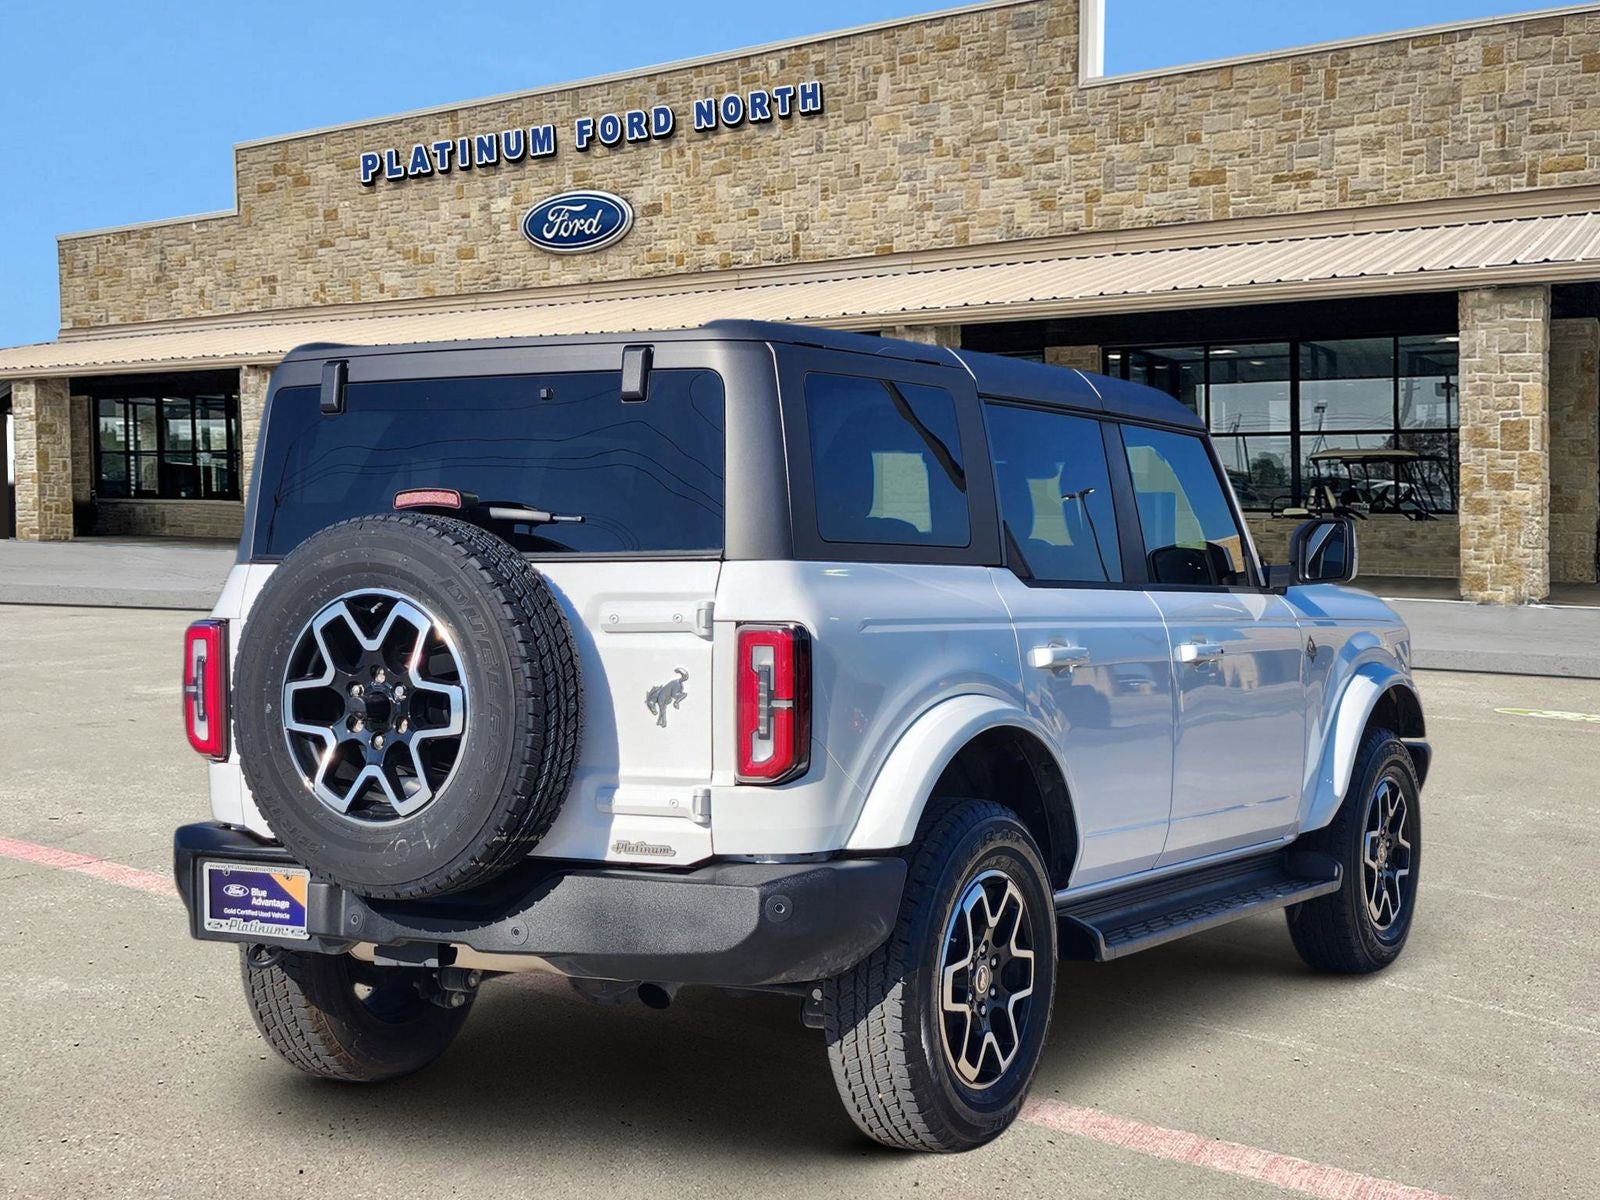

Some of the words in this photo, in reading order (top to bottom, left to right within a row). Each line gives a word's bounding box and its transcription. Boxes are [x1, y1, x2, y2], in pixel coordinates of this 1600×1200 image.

[360, 124, 556, 183] PLATINUM
[575, 104, 673, 149] FORD
[693, 81, 821, 130] NORTH
[542, 203, 603, 240] Ford
[614, 841, 672, 856] Platinum
[251, 888, 267, 897] Blue
[251, 897, 290, 909] Advantage
[237, 909, 258, 917] Certified
[259, 910, 271, 918] Used
[229, 919, 285, 935] Platinum
